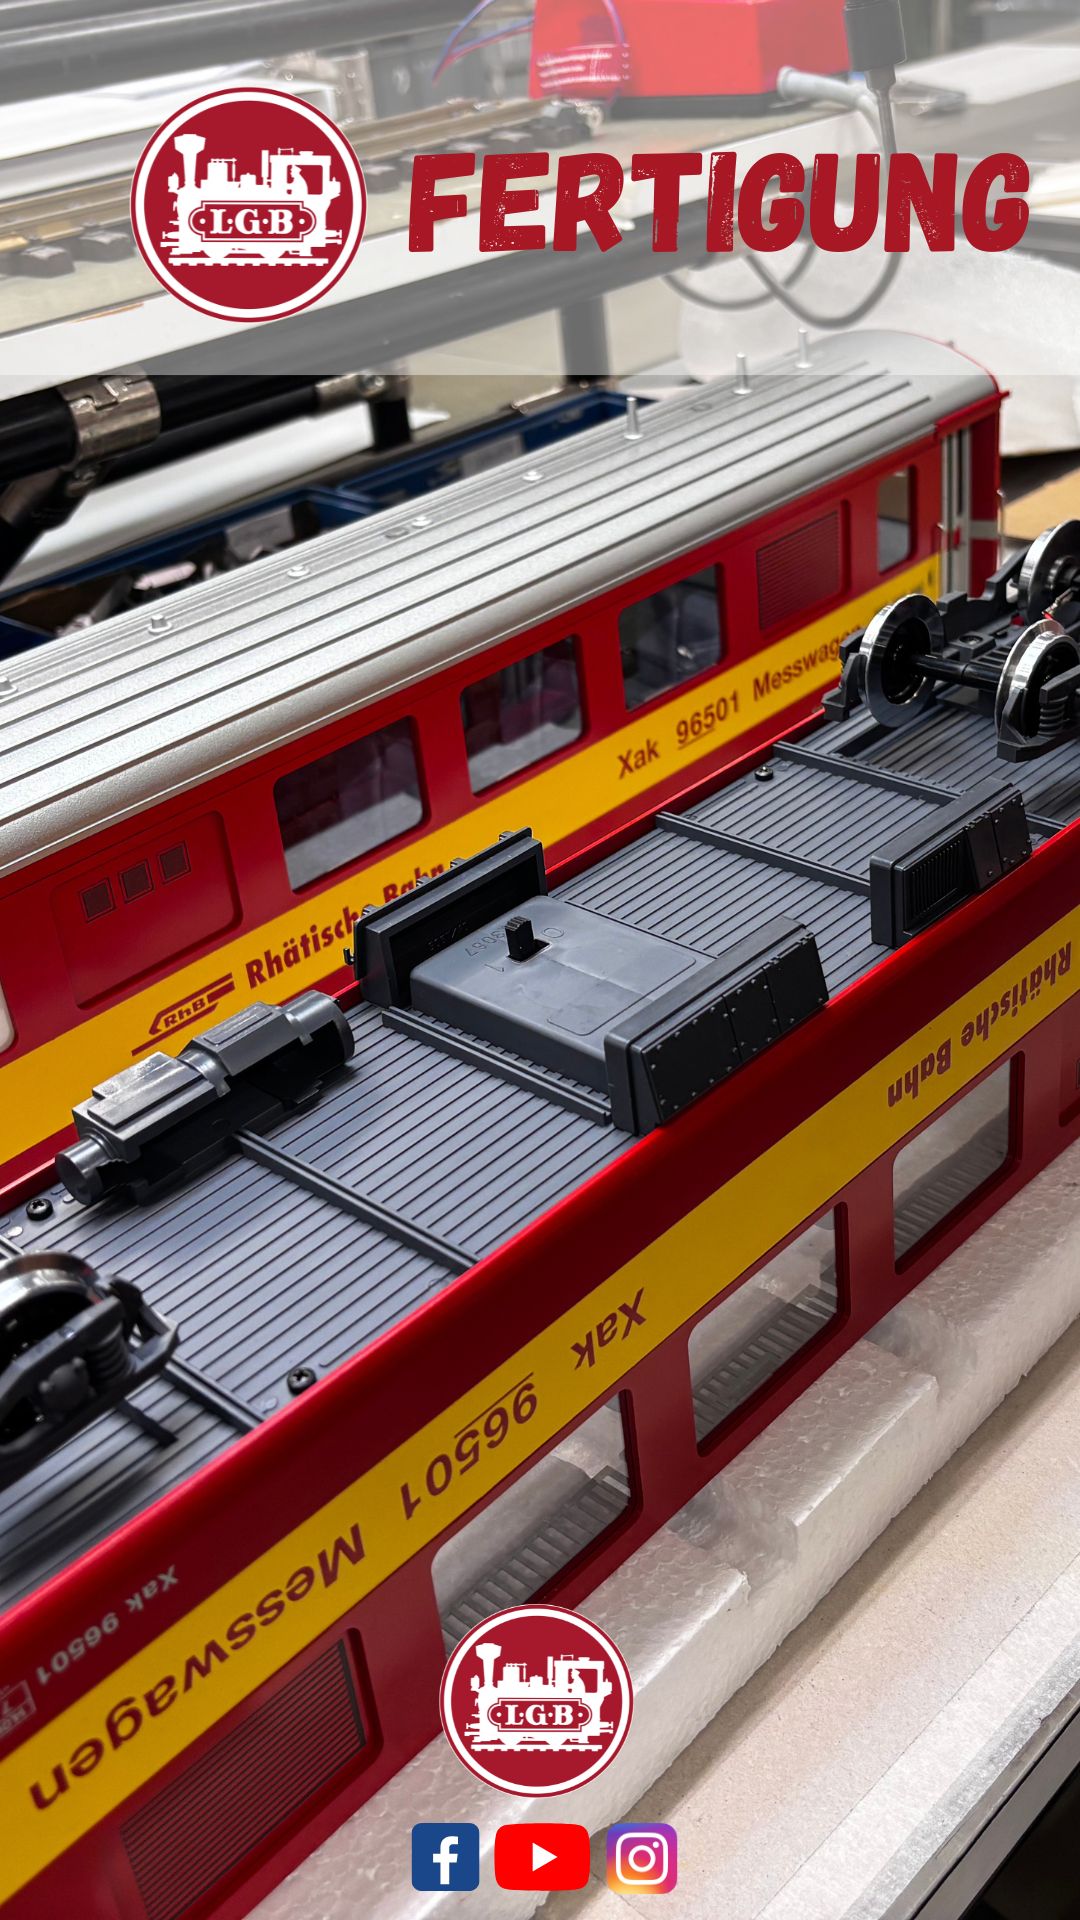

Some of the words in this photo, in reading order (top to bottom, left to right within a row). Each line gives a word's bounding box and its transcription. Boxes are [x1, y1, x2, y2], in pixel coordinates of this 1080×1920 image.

[617, 738, 660, 779] Xak
[675, 689, 740, 750] 96501
[753, 625, 861, 702] Messwag
[245, 905, 361, 990] Rhätisch
[163, 997, 206, 1028] RhB
[960, 941, 1072, 1047] Rhätische
[887, 1038, 952, 1108] Bahn
[570, 1287, 647, 1370] Xak
[400, 1374, 538, 1521] 96501
[125, 1565, 178, 1613] Xak
[28, 1523, 366, 1811] Messwagen
[36, 1612, 120, 1686] 96501
